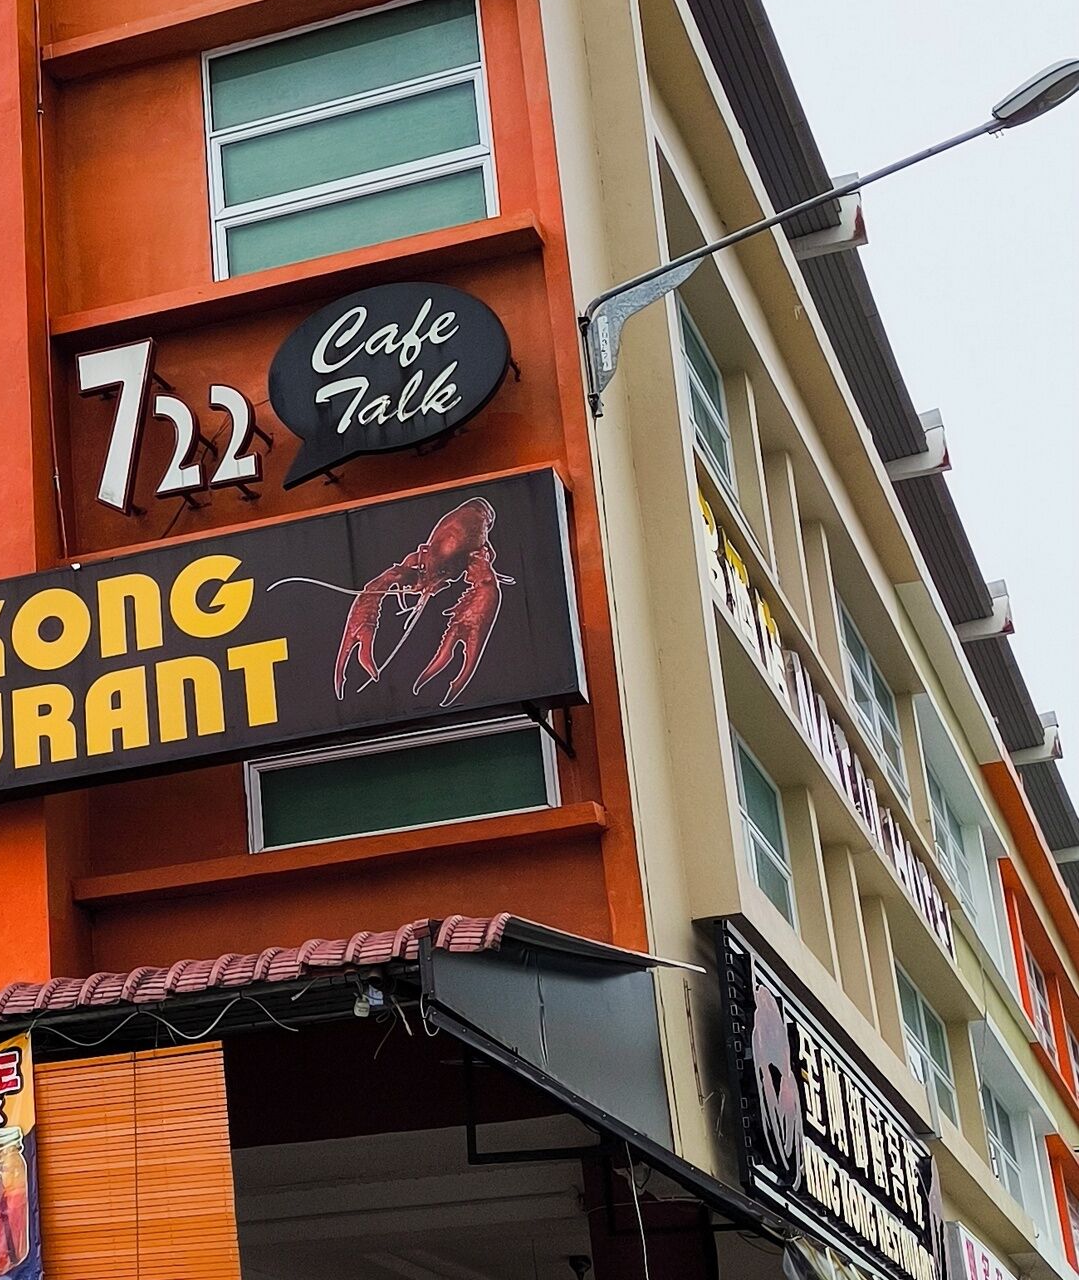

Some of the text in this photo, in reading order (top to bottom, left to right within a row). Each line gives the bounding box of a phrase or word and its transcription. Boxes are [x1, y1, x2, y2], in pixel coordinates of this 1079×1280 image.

[311, 297, 460, 375] Cafe
[77, 336, 261, 515] 722
[316, 360, 463, 434] Talk
[802, 1135, 841, 1218] KING
[839, 1166, 878, 1249] KONG
